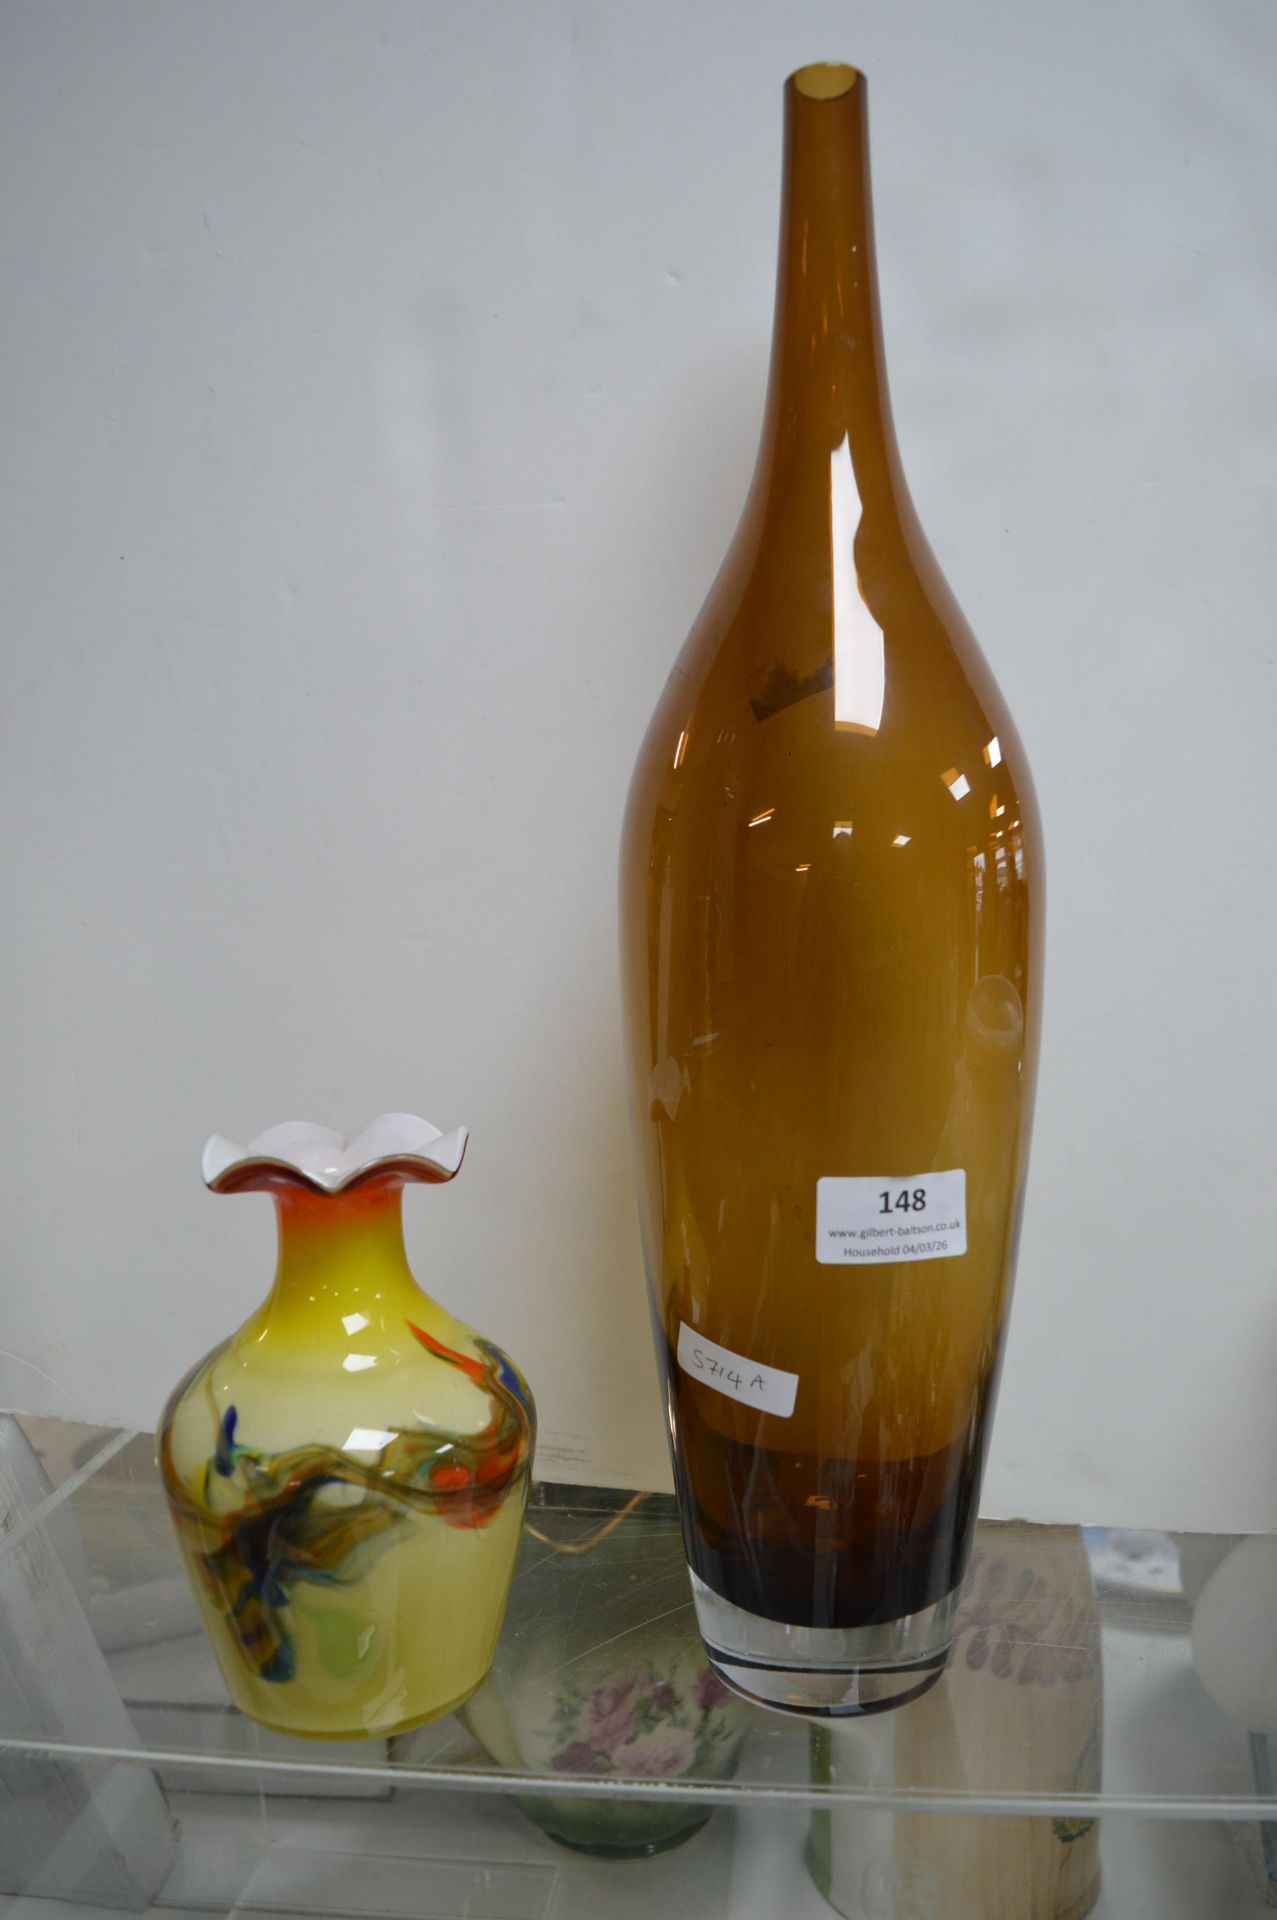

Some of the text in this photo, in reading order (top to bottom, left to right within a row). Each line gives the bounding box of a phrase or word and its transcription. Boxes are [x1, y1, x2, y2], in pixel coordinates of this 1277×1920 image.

[879, 1188, 927, 1214] 148
[828, 1219, 961, 1240] www.gilbert-baitson.co.uk
[843, 1240, 948, 1258] Household 04/03/26
